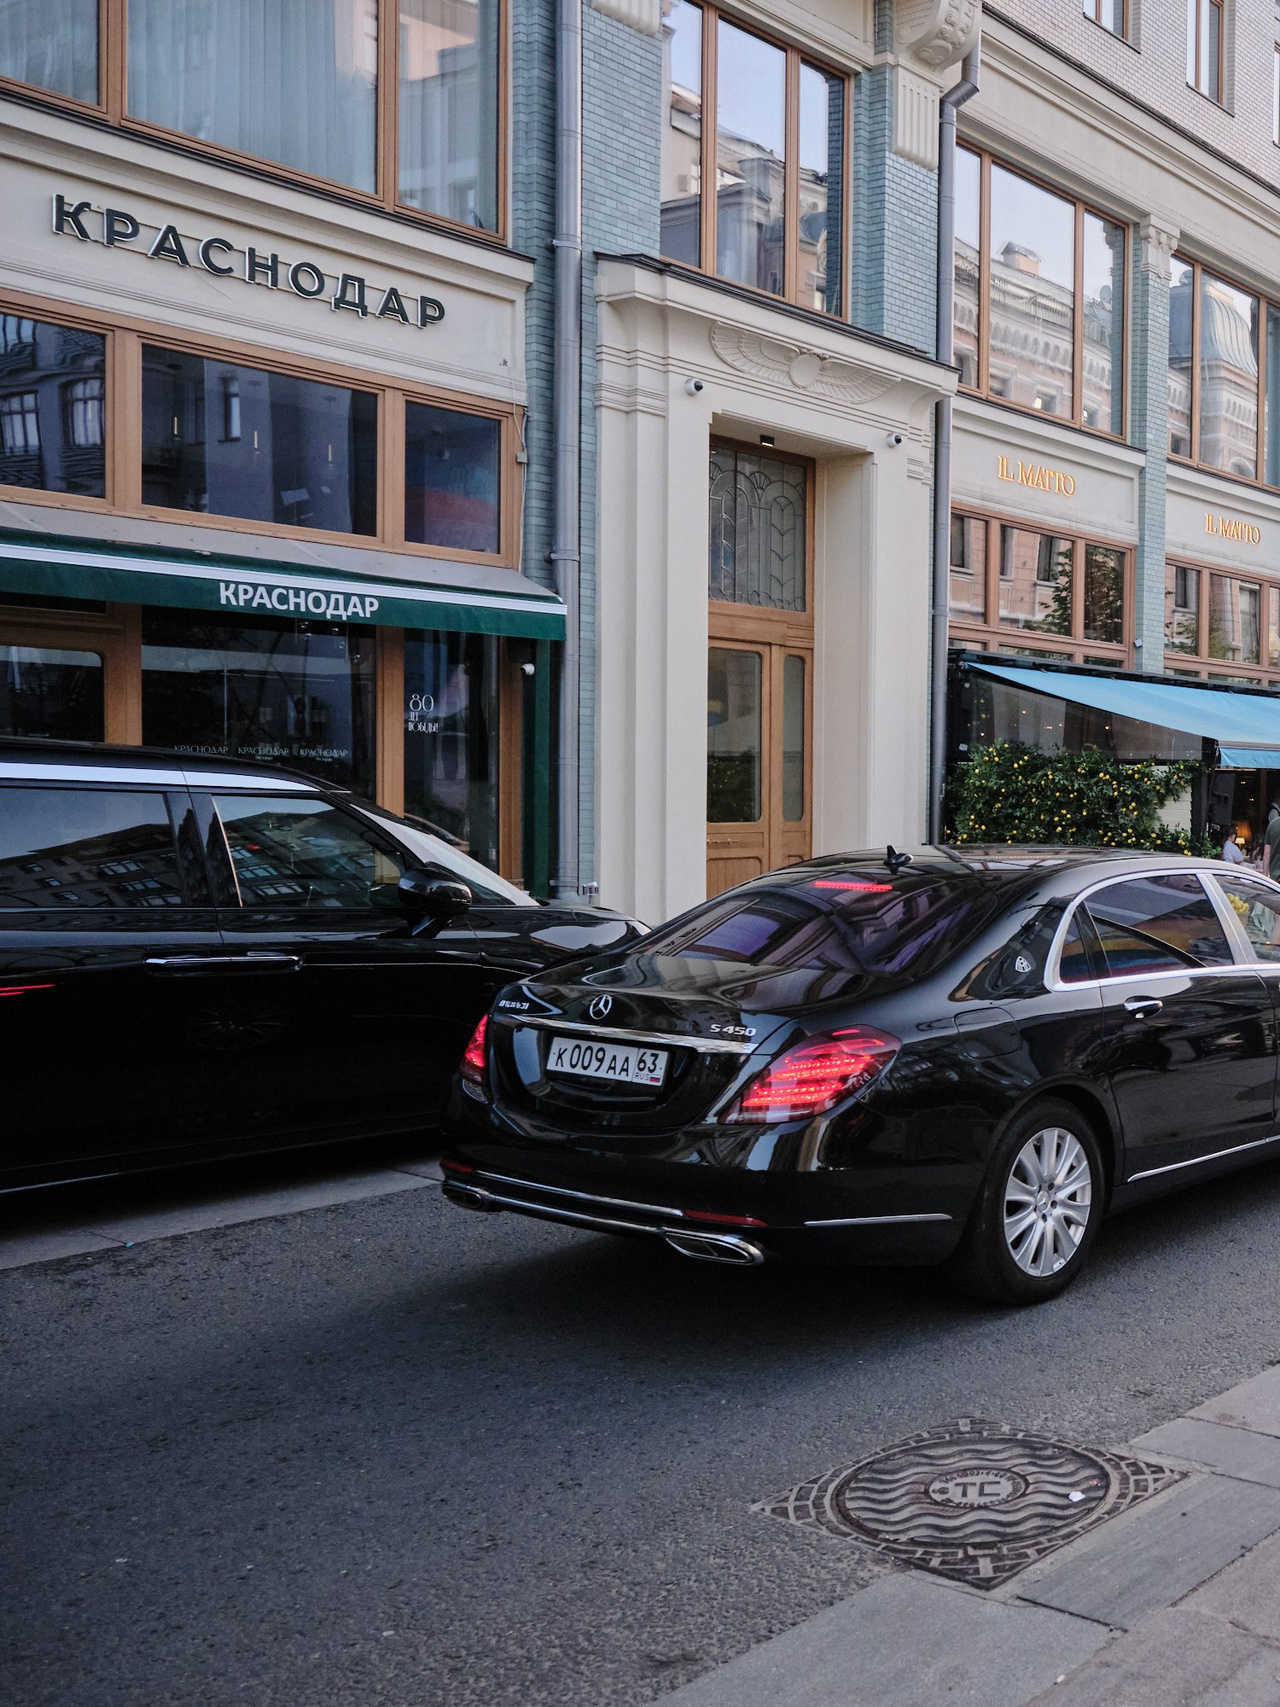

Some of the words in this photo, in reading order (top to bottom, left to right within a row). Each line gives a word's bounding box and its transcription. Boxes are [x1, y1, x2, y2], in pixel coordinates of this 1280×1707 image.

[51, 193, 446, 329] КРАСНОДАР
[998, 455, 1015, 482] IL
[1018, 461, 1076, 497] MATTO
[1205, 513, 1217, 536] IL
[1219, 517, 1261, 546] MATTO
[219, 582, 380, 621] КРАСНОДАР
[409, 693, 434, 712] 80
[174, 744, 229, 755] КРАСНОДАР
[238, 746, 290, 756] КРАСНОДАР
[300, 748, 348, 758] КРАСНОДАР
[709, 1023, 722, 1034] S
[722, 1025, 757, 1037] 450
[637, 1047, 657, 1074] 63
[634, 1072, 650, 1082] RUS
